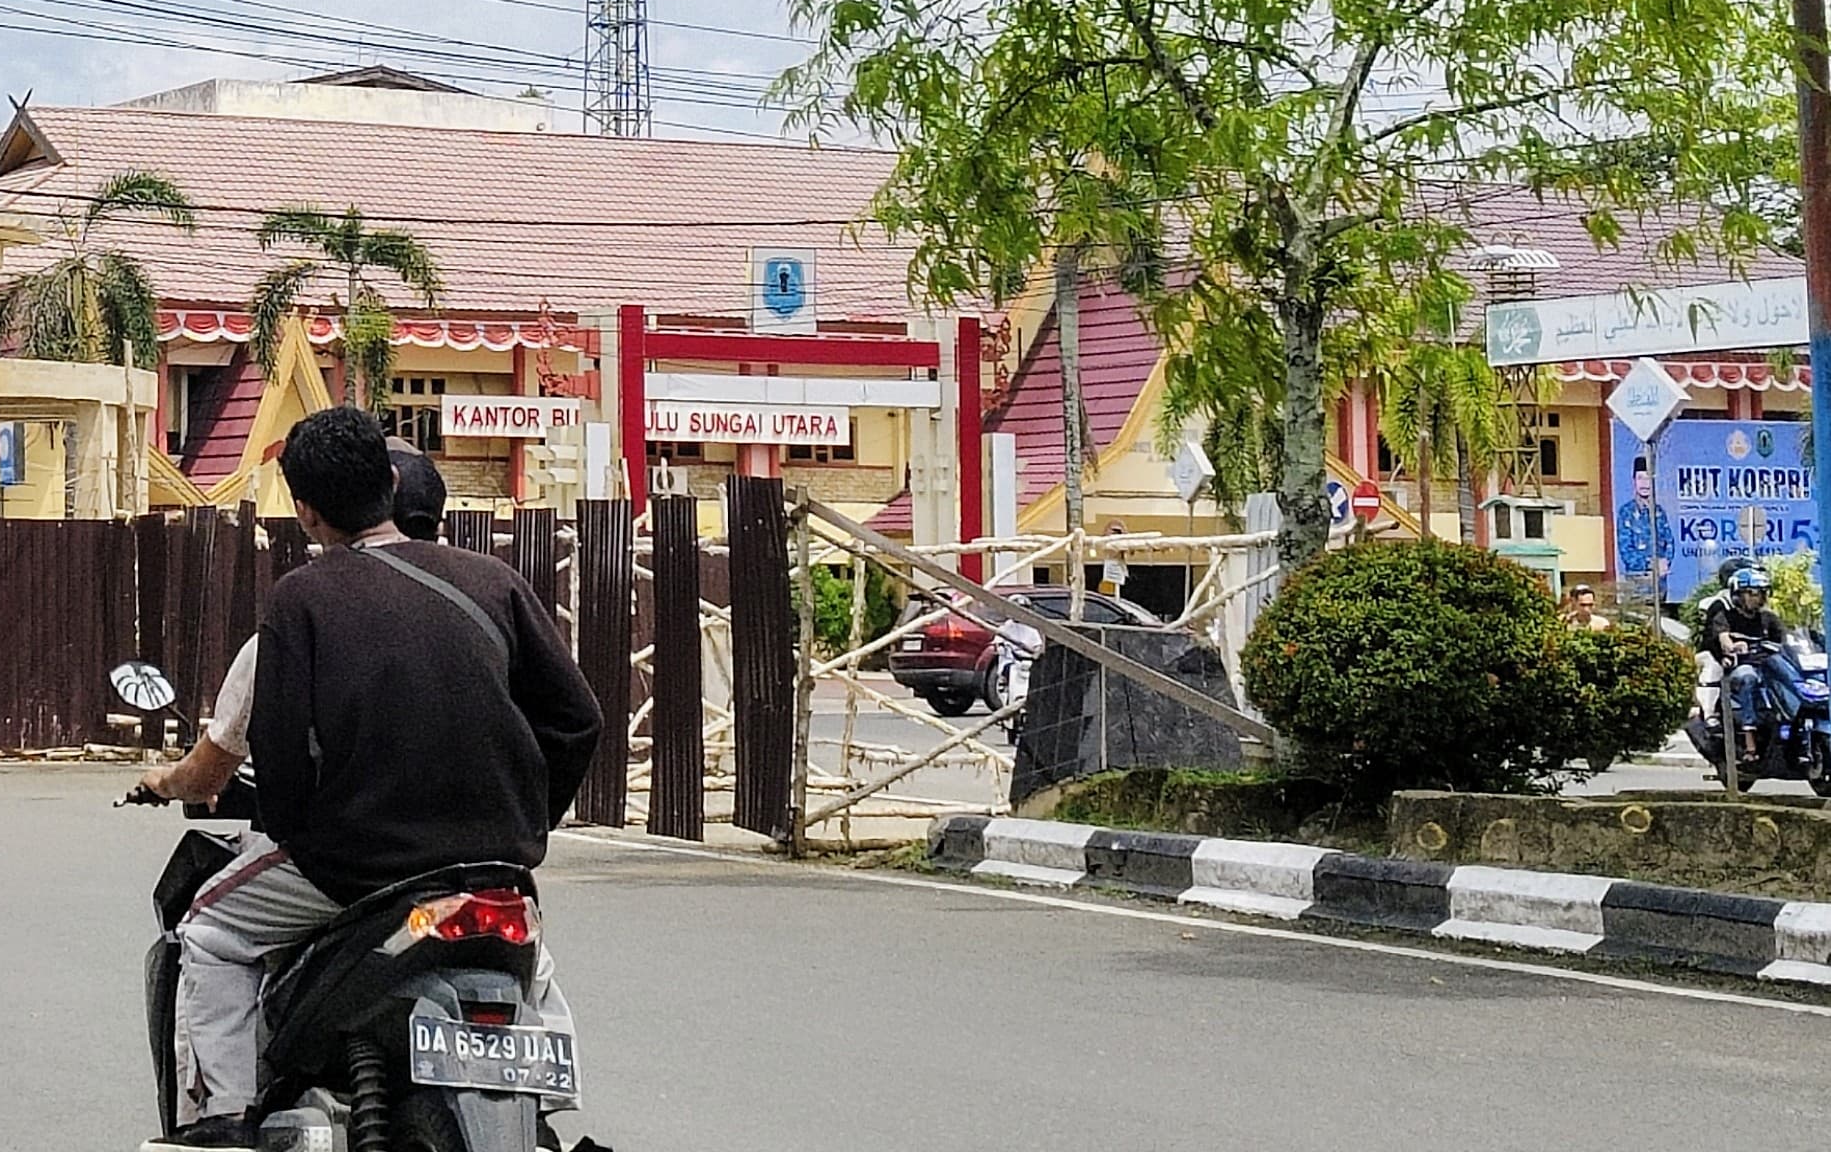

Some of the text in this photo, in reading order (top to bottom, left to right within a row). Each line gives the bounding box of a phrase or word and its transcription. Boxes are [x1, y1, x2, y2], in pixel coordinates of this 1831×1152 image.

[453, 404, 540, 429] KANTOR
[689, 412, 763, 434] SUNGAI
[772, 414, 838, 435] UTARA
[1678, 467, 1721, 498] HUT
[1680, 518, 1783, 542] KORRI
[415, 1024, 447, 1052] DA
[455, 1031, 516, 1060] 6529
